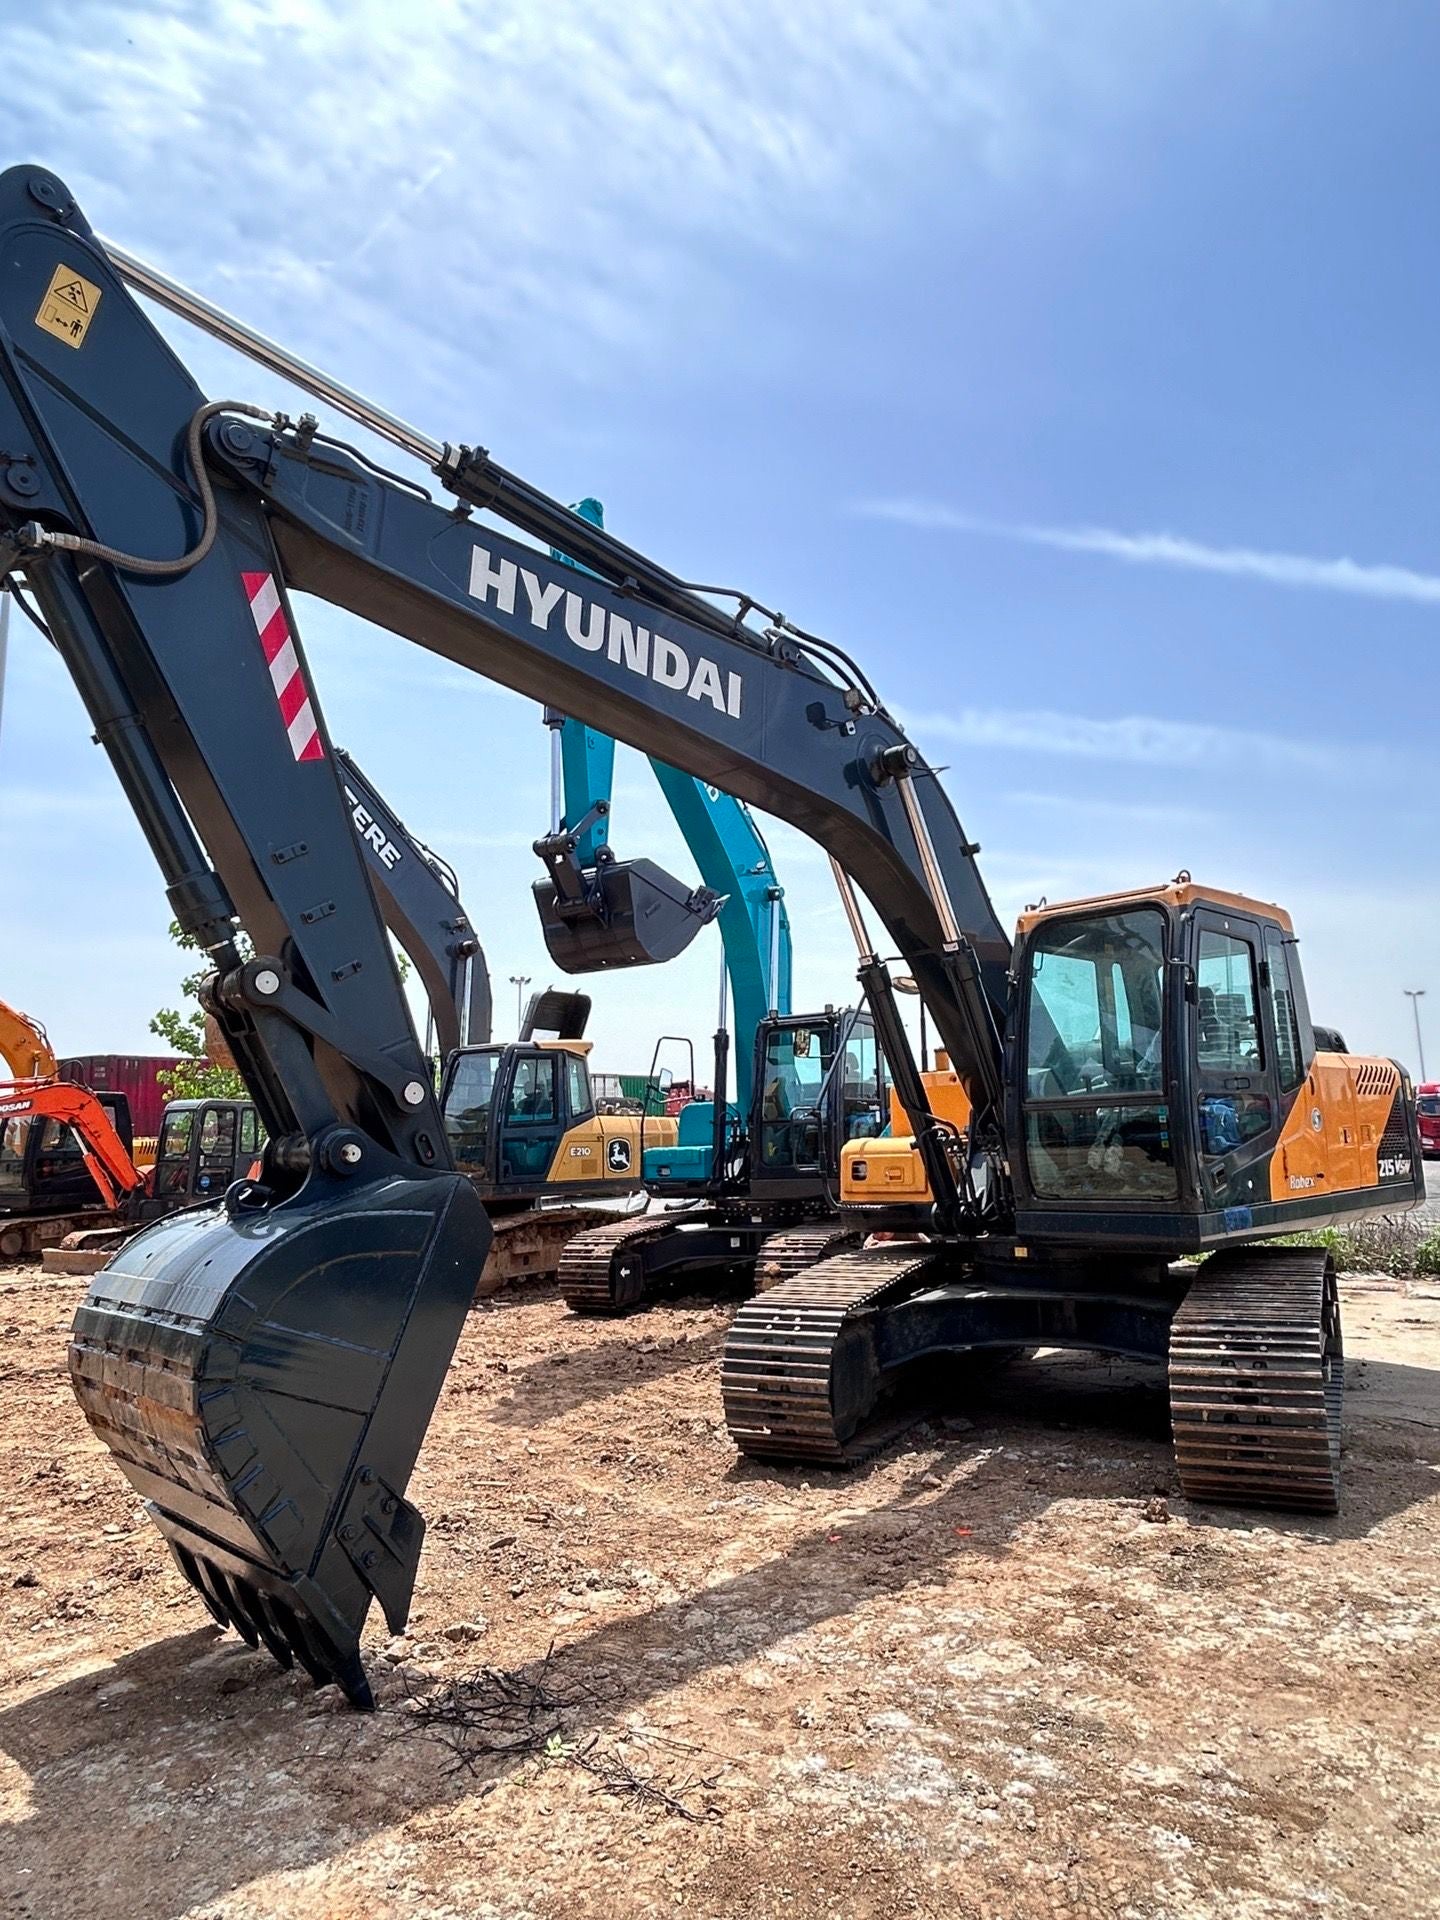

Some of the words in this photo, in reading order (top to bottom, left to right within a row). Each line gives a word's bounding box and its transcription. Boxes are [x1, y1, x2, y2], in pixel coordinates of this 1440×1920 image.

[469, 544, 742, 719] HYUNDAI
[570, 1147, 591, 1156] E210
[1290, 1175, 1315, 1189] Robex
